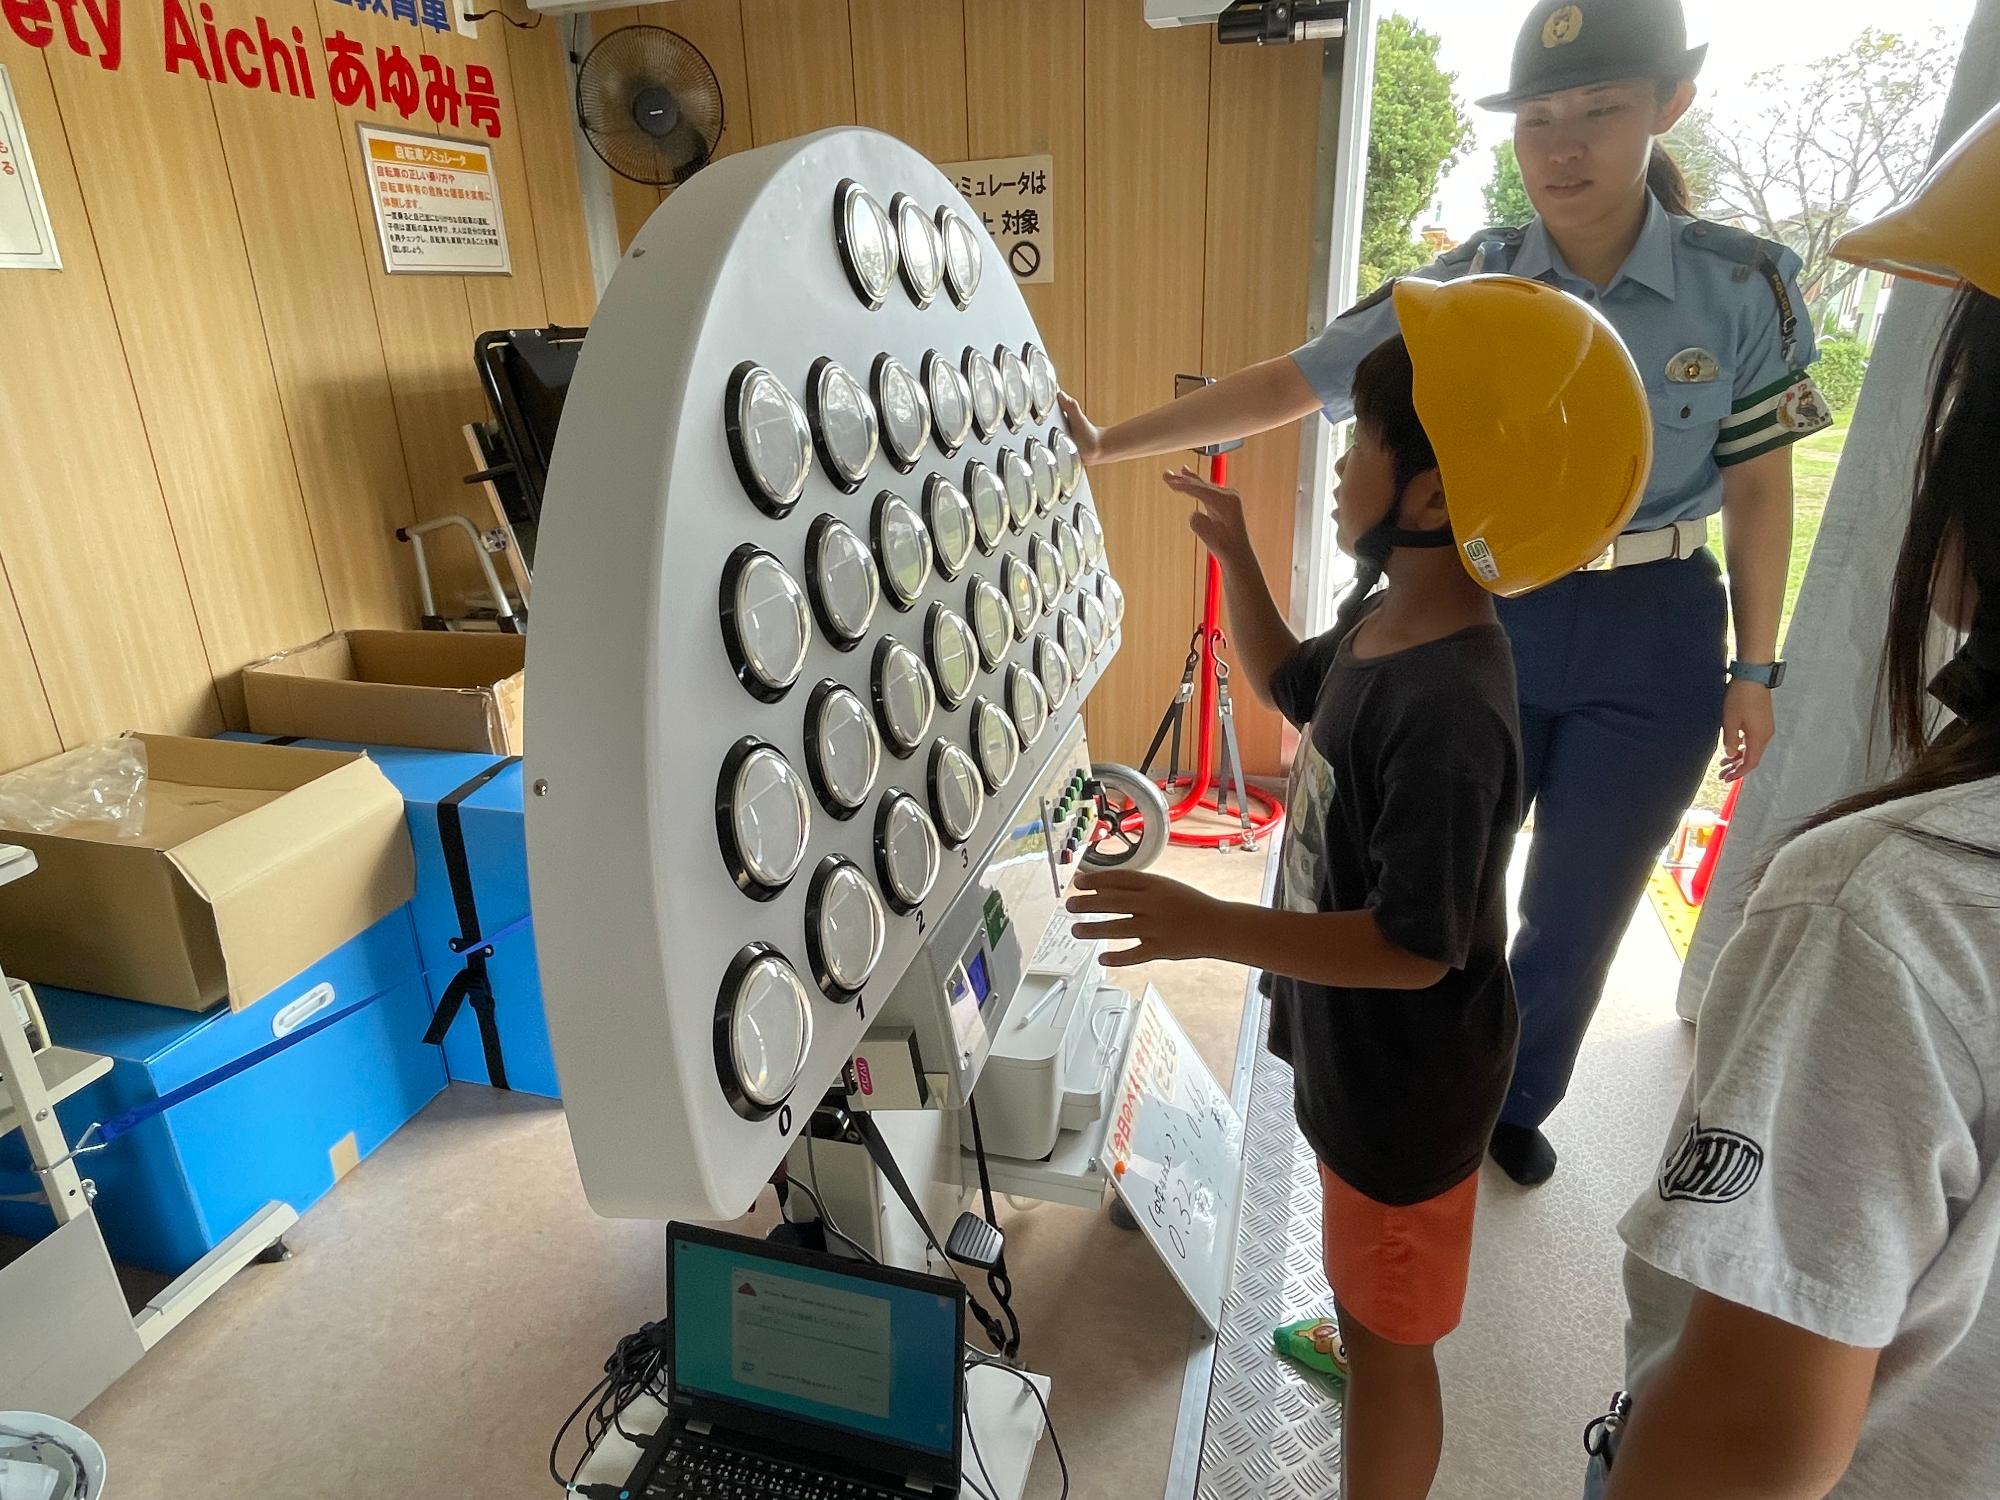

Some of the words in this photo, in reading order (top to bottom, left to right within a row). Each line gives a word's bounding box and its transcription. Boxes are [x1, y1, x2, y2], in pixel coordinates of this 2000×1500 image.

[163, 0, 316, 99] Aichi
[325, 30, 501, 138] あゆみ号
[947, 170, 1047, 198] ミュレータは
[915, 909, 925, 936] 2
[856, 995, 865, 1021] 1
[778, 1104, 792, 1136] 0
